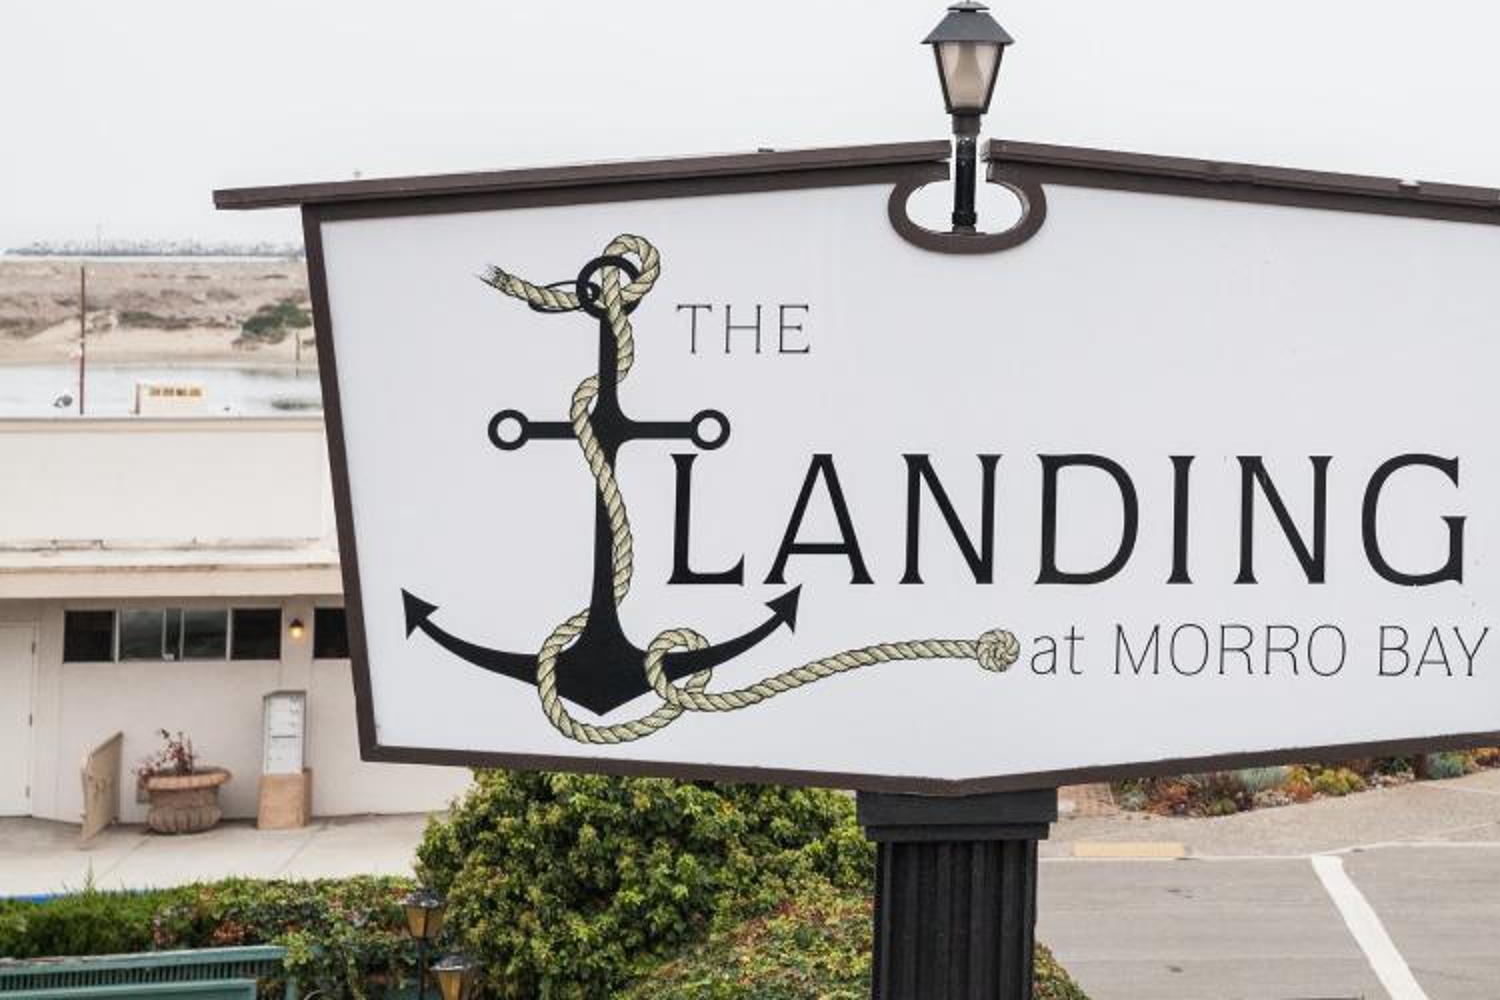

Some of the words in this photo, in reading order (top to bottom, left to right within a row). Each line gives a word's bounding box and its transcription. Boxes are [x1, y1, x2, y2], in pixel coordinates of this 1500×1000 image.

[676, 304, 811, 354] THE
[666, 453, 1467, 587] LANDING
[1030, 625, 1085, 677] at
[1114, 623, 1347, 677] MORRO
[1378, 625, 1489, 677] BAY
